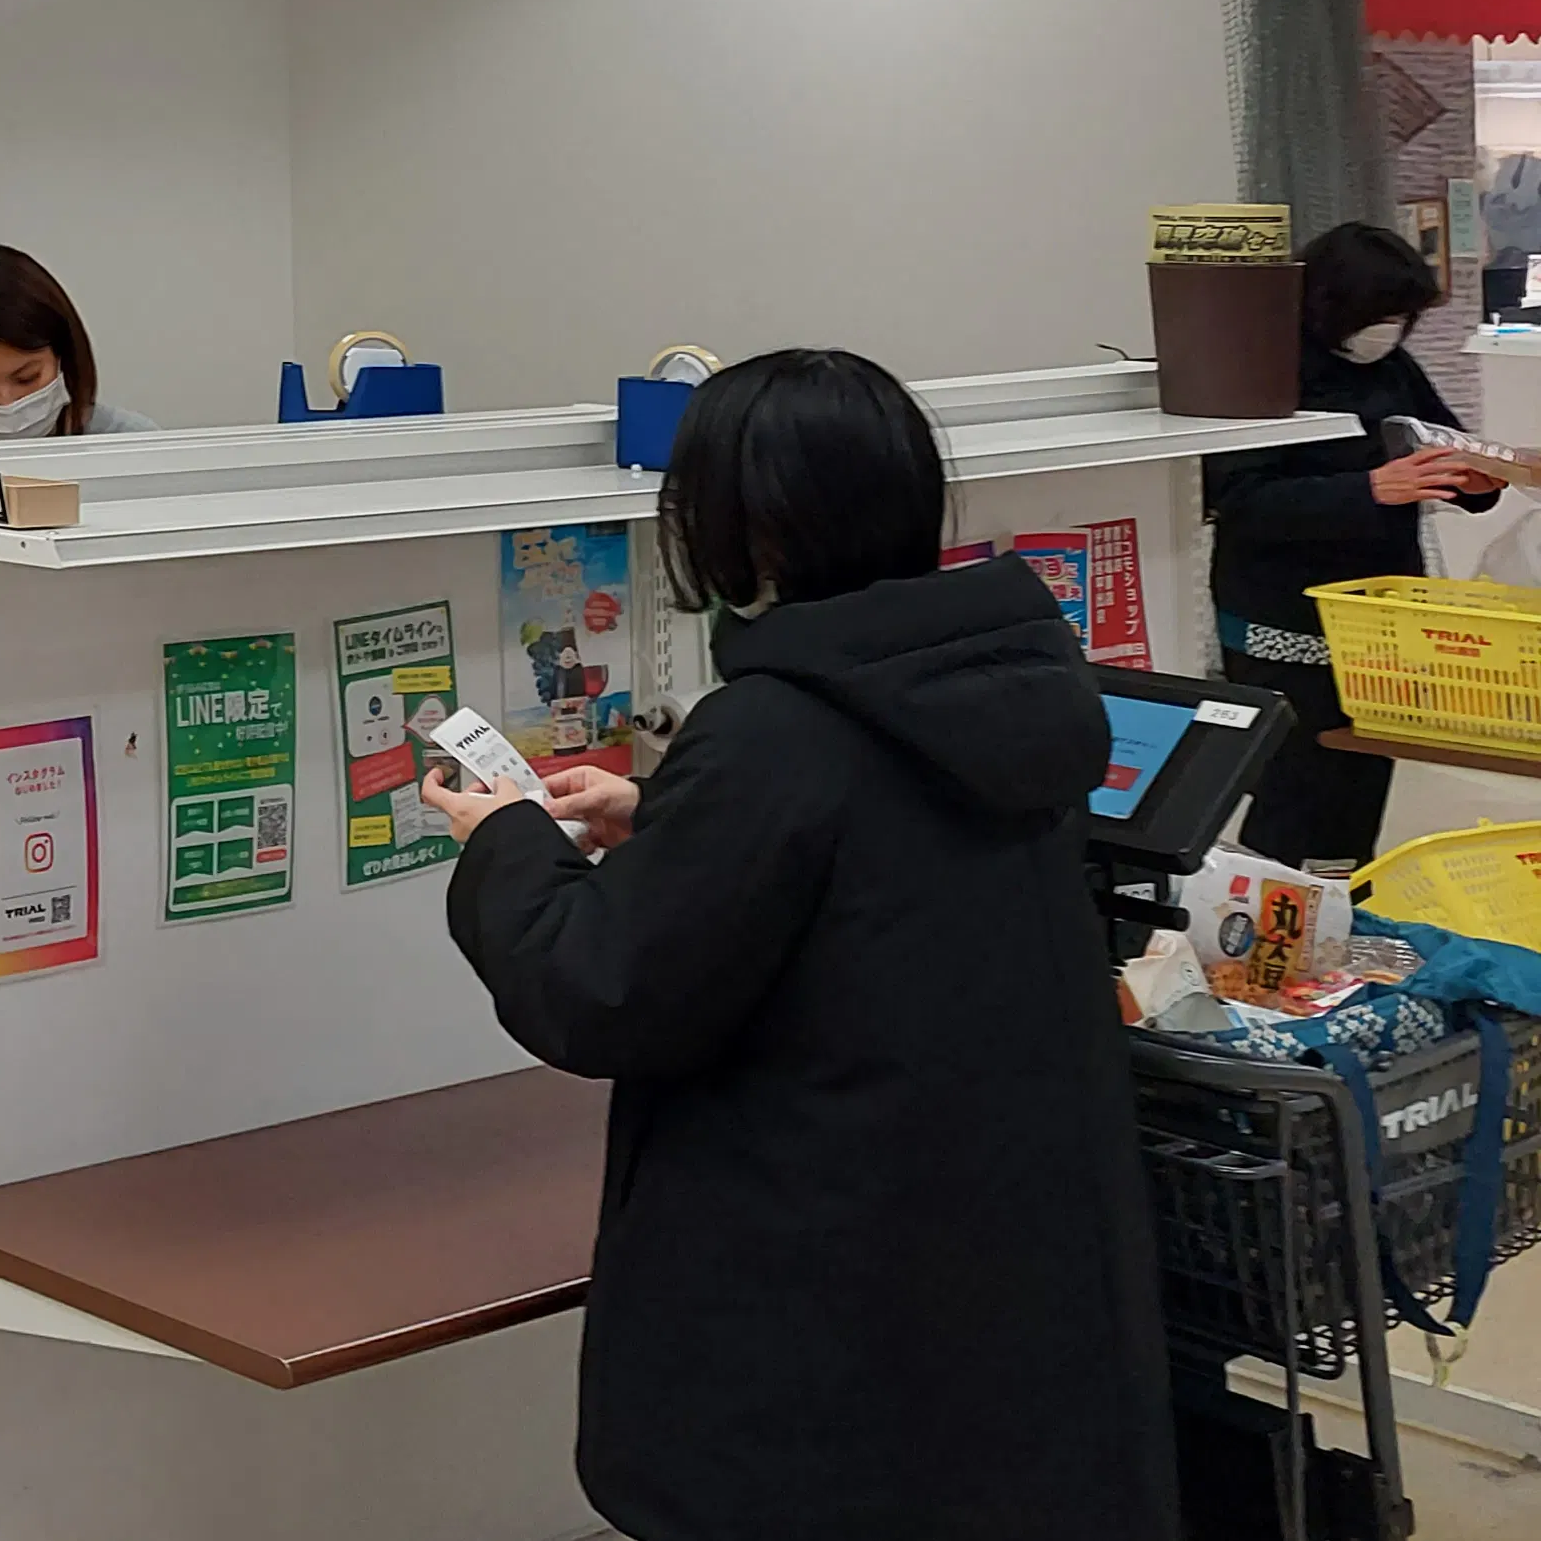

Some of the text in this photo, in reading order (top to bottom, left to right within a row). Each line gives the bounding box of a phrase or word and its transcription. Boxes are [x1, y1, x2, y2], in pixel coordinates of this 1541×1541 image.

[1420, 628, 1492, 647] TRIAL
[176, 689, 283, 727] LINE限定で
[455, 725, 490, 750] TRIAL
[5, 903, 46, 919] TRIAL
[1380, 1083, 1478, 1139] TRIAL
